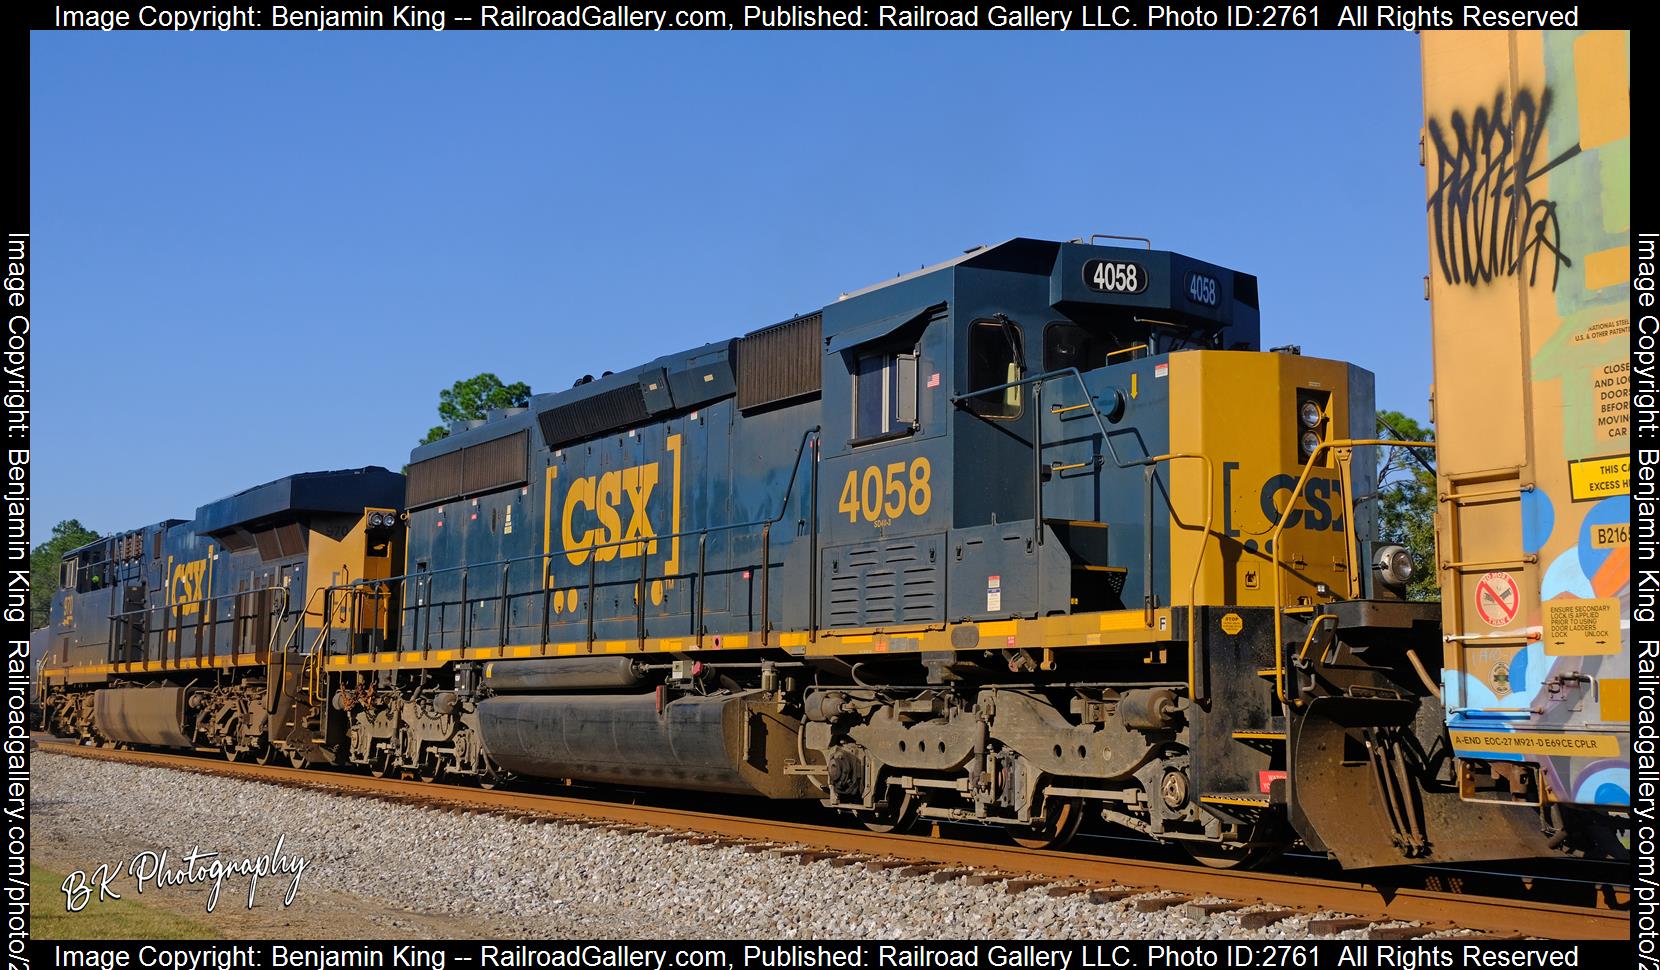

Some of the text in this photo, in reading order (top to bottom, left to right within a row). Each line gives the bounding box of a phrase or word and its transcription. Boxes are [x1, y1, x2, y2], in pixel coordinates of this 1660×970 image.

[1093, 262, 1138, 292] 4058
[1189, 275, 1216, 305] 4058
[1591, 330, 1608, 339] OTHER
[1603, 362, 1630, 375] CLOSE
[1594, 378, 1614, 389] AND
[1600, 388, 1630, 400] DOOR
[1601, 401, 1630, 413] BEFOR
[1598, 414, 1630, 426] MOVIN
[1608, 427, 1628, 438] CAR
[1600, 464, 1619, 475] THIS
[838, 456, 932, 523] 4058
[1589, 480, 1620, 492] EXCESS
[561, 462, 659, 566] CSX
[1598, 526, 1630, 545] B216
[171, 559, 207, 618] CSX
[1550, 605, 1610, 614] ENSURE SECONDARY
[1575, 611, 1600, 619] APPLIED
[1569, 624, 1597, 632] LADDERS
[1584, 630, 1609, 638] UNLOCK
[1455, 736, 1481, 745] A-END
[1484, 737, 1512, 746] EOC-27
[1545, 738, 1574, 748] E69CE
[1574, 739, 1598, 749] CPLR
